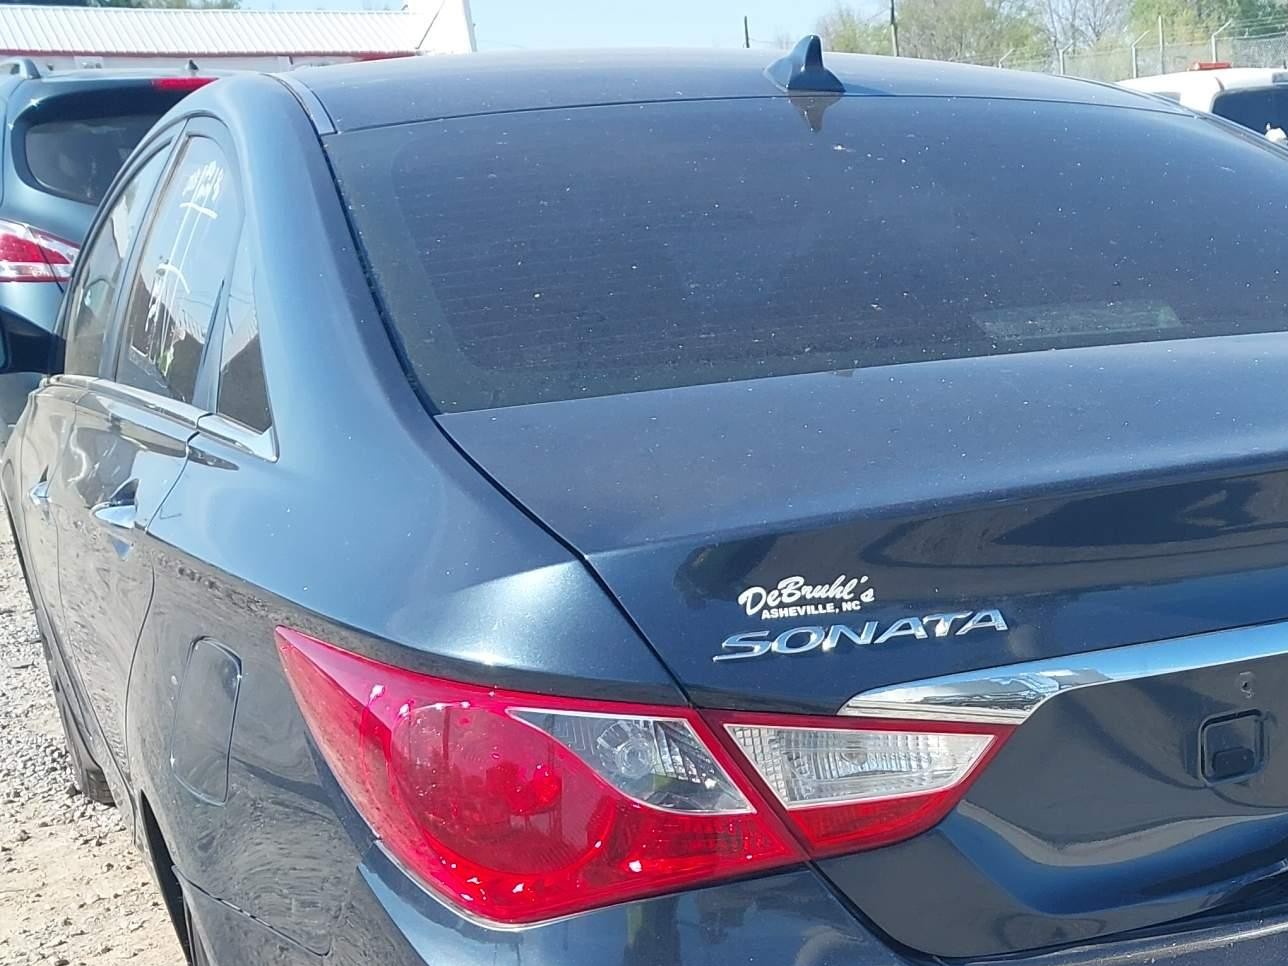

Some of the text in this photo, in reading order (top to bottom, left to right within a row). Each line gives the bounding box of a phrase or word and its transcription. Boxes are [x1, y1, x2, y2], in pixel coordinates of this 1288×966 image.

[738, 574, 875, 616] DeBruhl's
[761, 600, 861, 620] ASHEVILLE, NC
[712, 608, 1008, 663] SONATA
